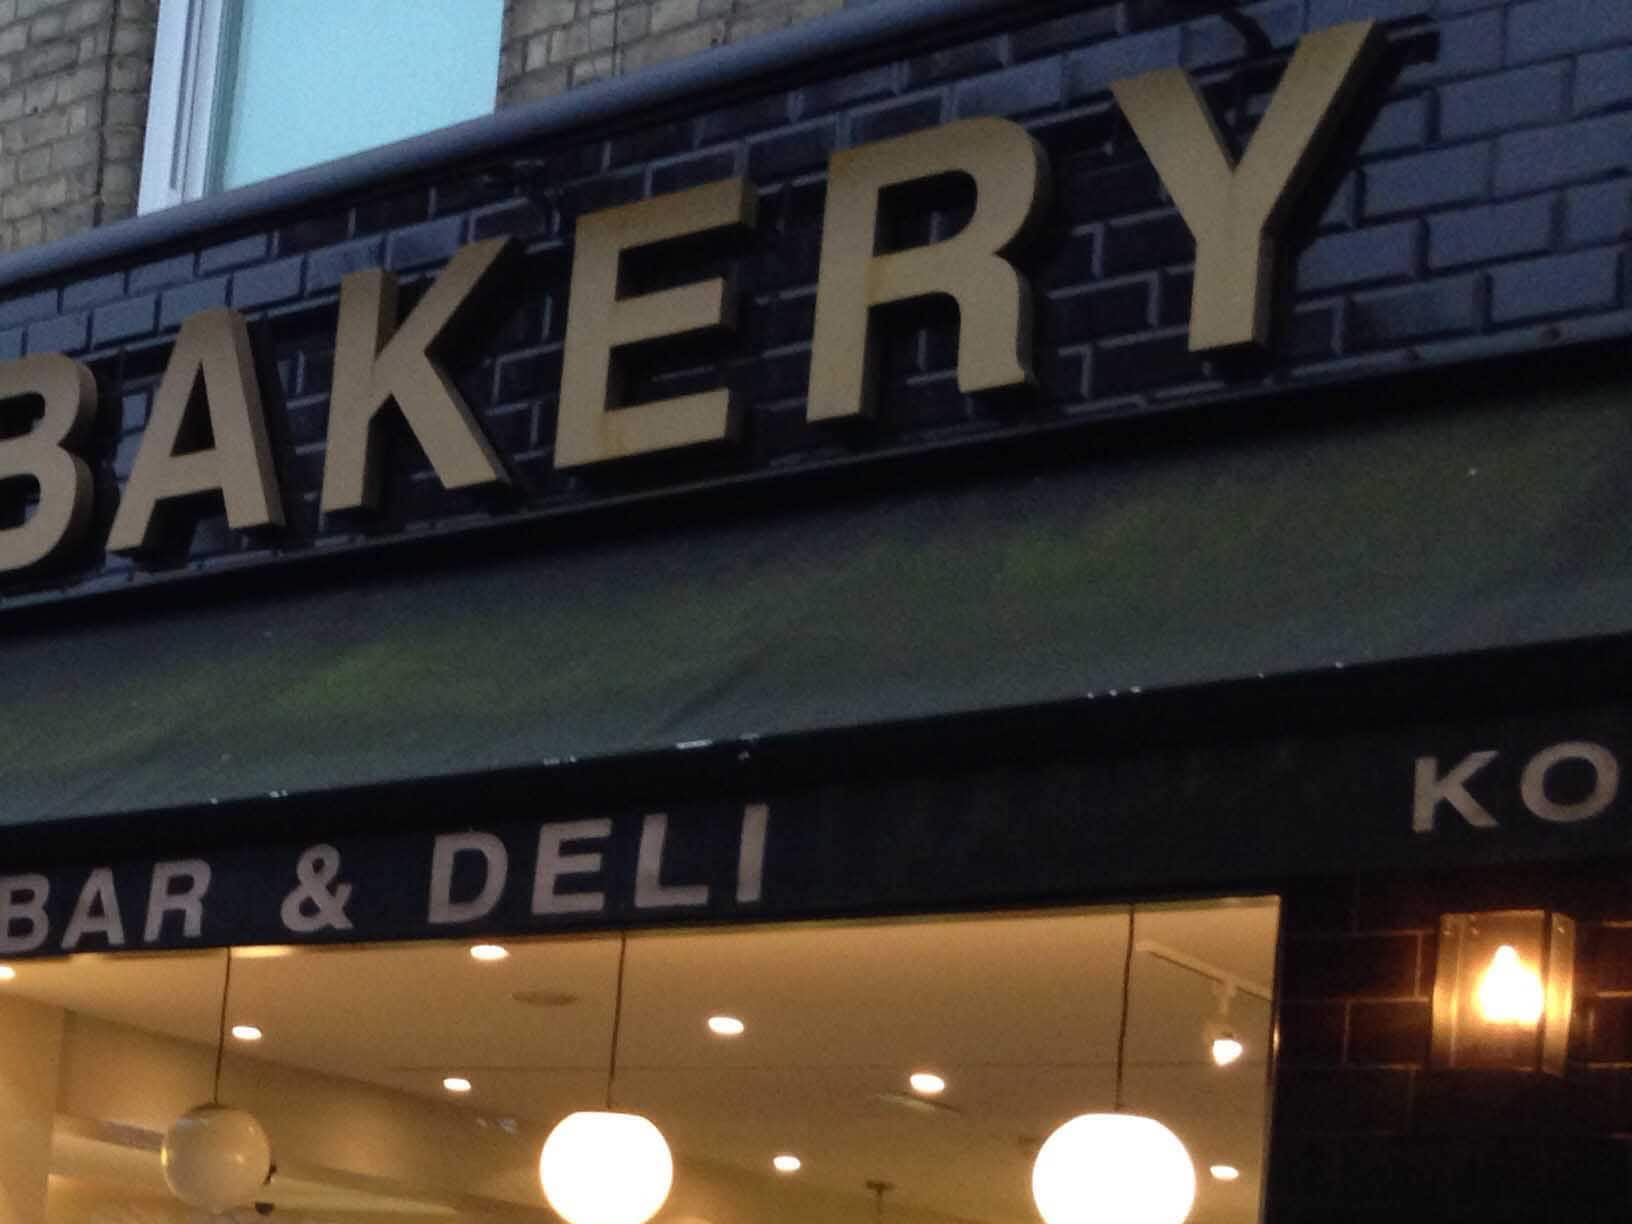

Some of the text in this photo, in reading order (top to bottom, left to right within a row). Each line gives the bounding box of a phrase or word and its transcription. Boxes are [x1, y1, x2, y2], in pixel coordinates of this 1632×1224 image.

[1411, 741, 1620, 833] KO
[279, 843, 354, 933] &
[427, 803, 769, 924] DELI
